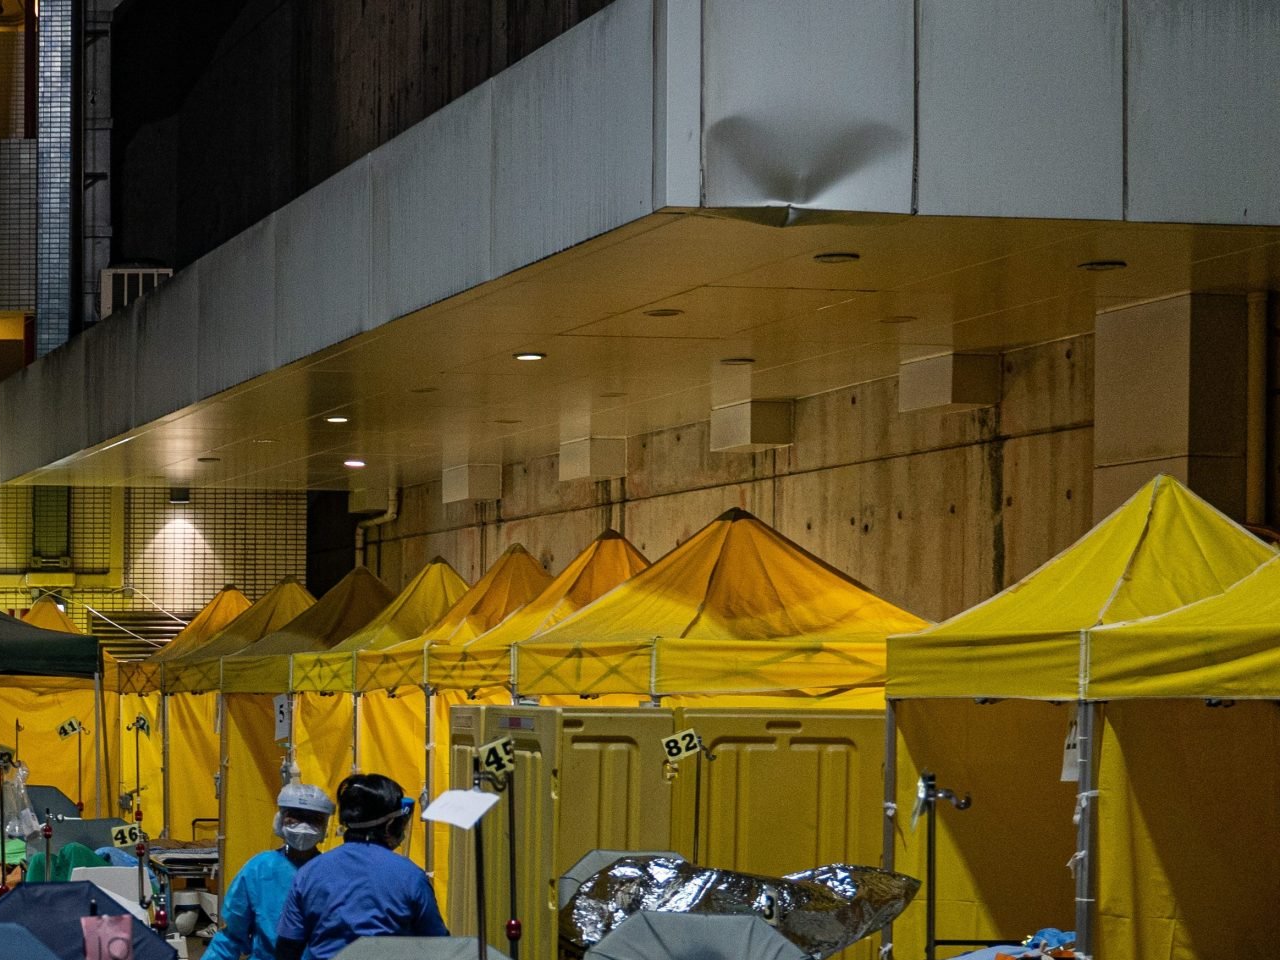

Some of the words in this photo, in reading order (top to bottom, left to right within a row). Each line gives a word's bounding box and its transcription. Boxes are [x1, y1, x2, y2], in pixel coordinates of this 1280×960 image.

[59, 721, 78, 736] 41
[665, 733, 698, 756] 82
[114, 827, 138, 845] 46
